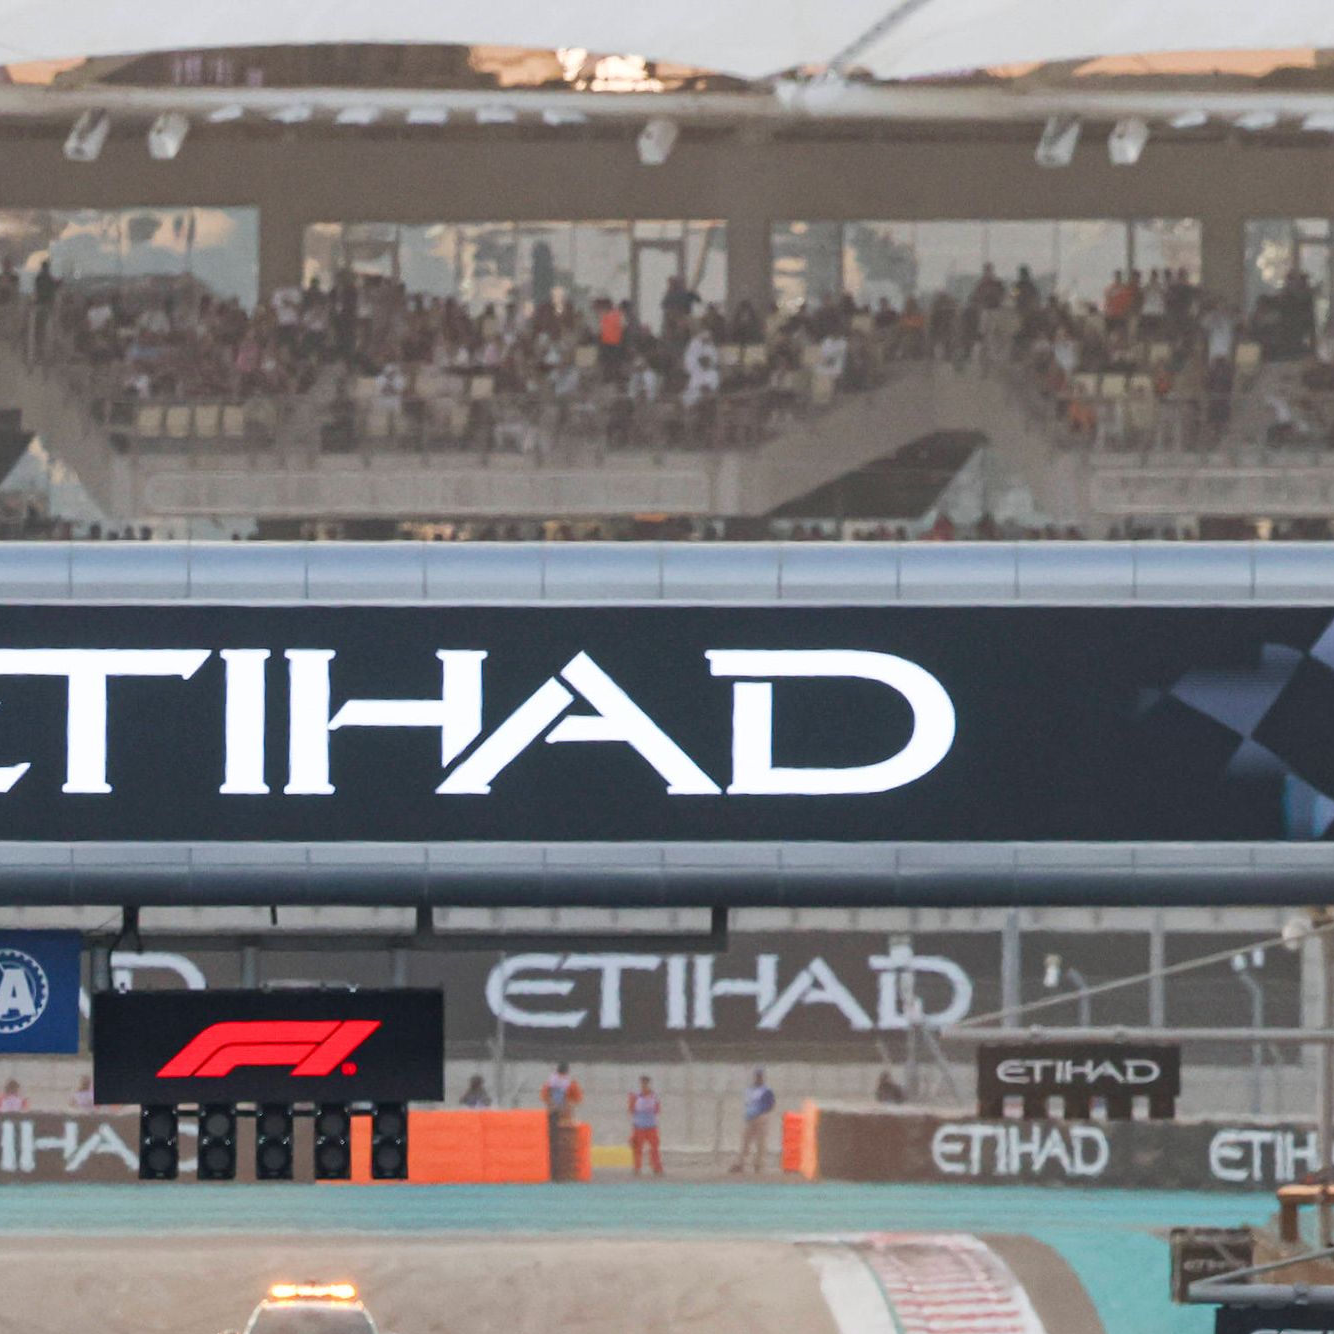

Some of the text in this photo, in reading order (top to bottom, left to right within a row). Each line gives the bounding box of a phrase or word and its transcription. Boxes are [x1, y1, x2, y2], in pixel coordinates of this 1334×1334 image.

[485, 952, 973, 1031] ETIHAD
[996, 1058, 1161, 1085] ETIHAD
[933, 1123, 1109, 1176] ETIHAD
